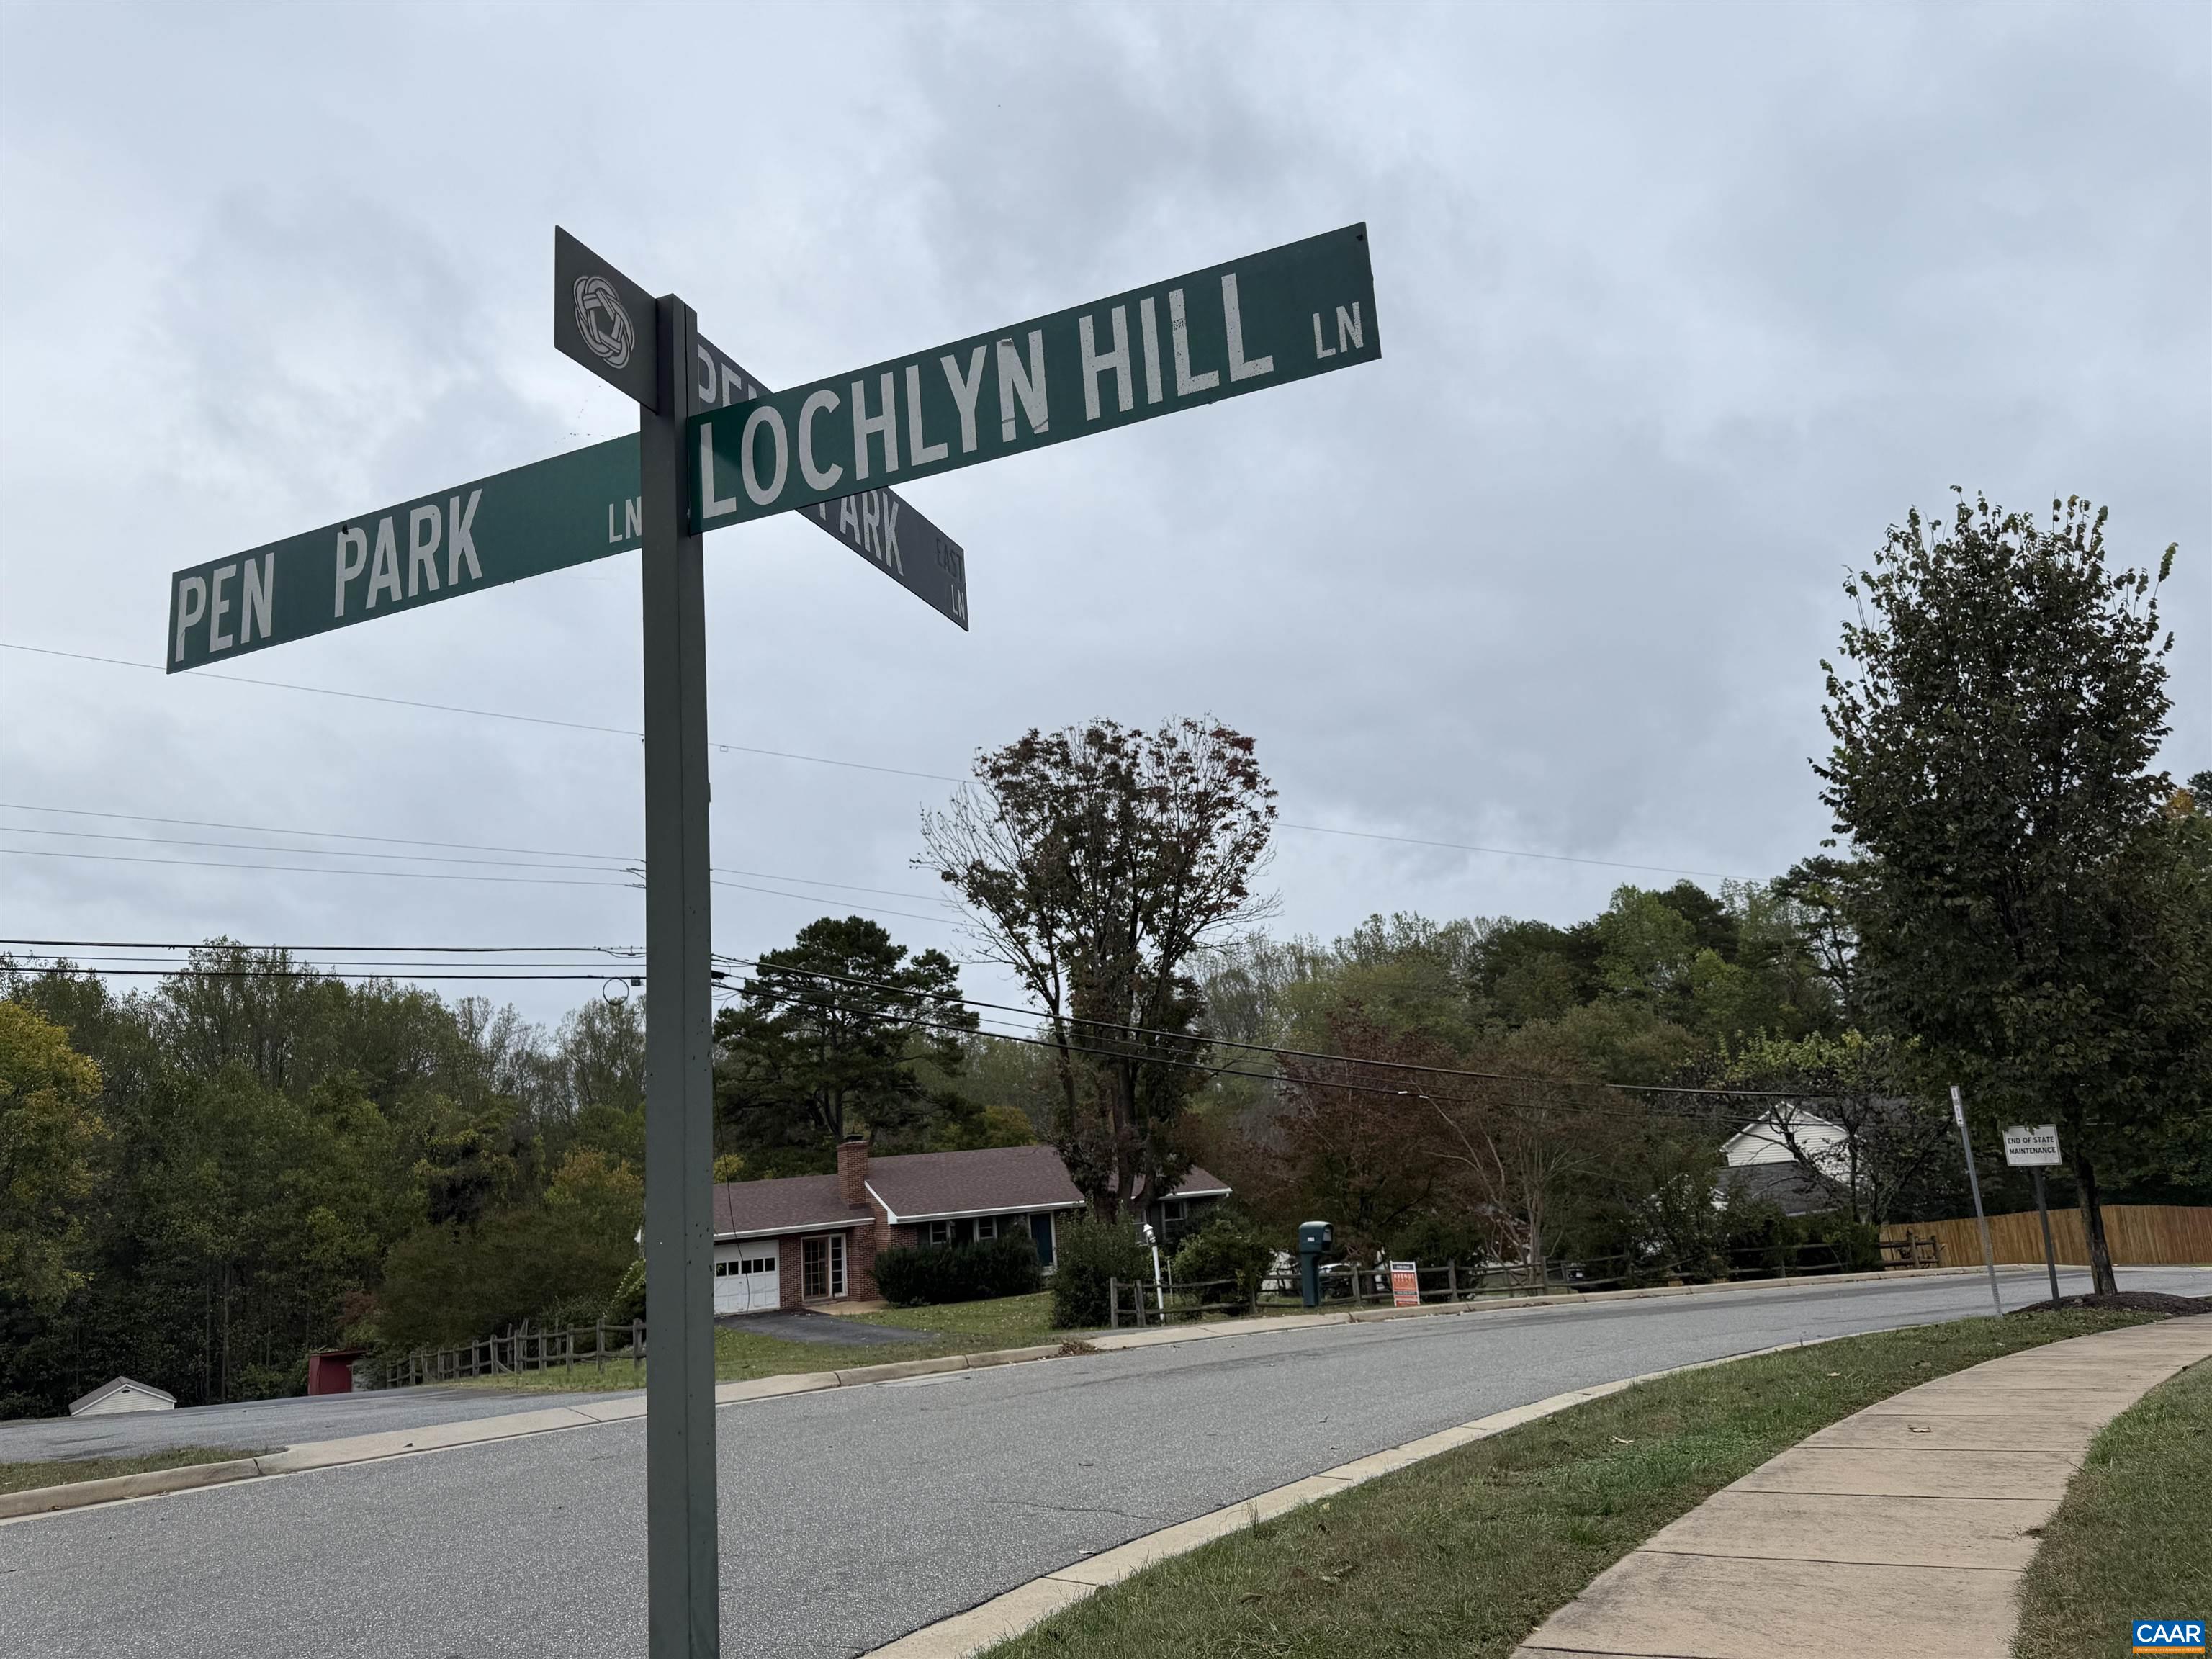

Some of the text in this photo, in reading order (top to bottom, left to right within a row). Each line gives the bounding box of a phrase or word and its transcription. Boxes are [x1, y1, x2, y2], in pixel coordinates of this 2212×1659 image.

[700, 273, 1364, 518] LOCHLYN HILL LN
[175, 488, 642, 662] PEN PARK LN
[819, 489, 904, 577] ARK
[950, 584, 966, 621] LN
[936, 538, 964, 583] EAST
